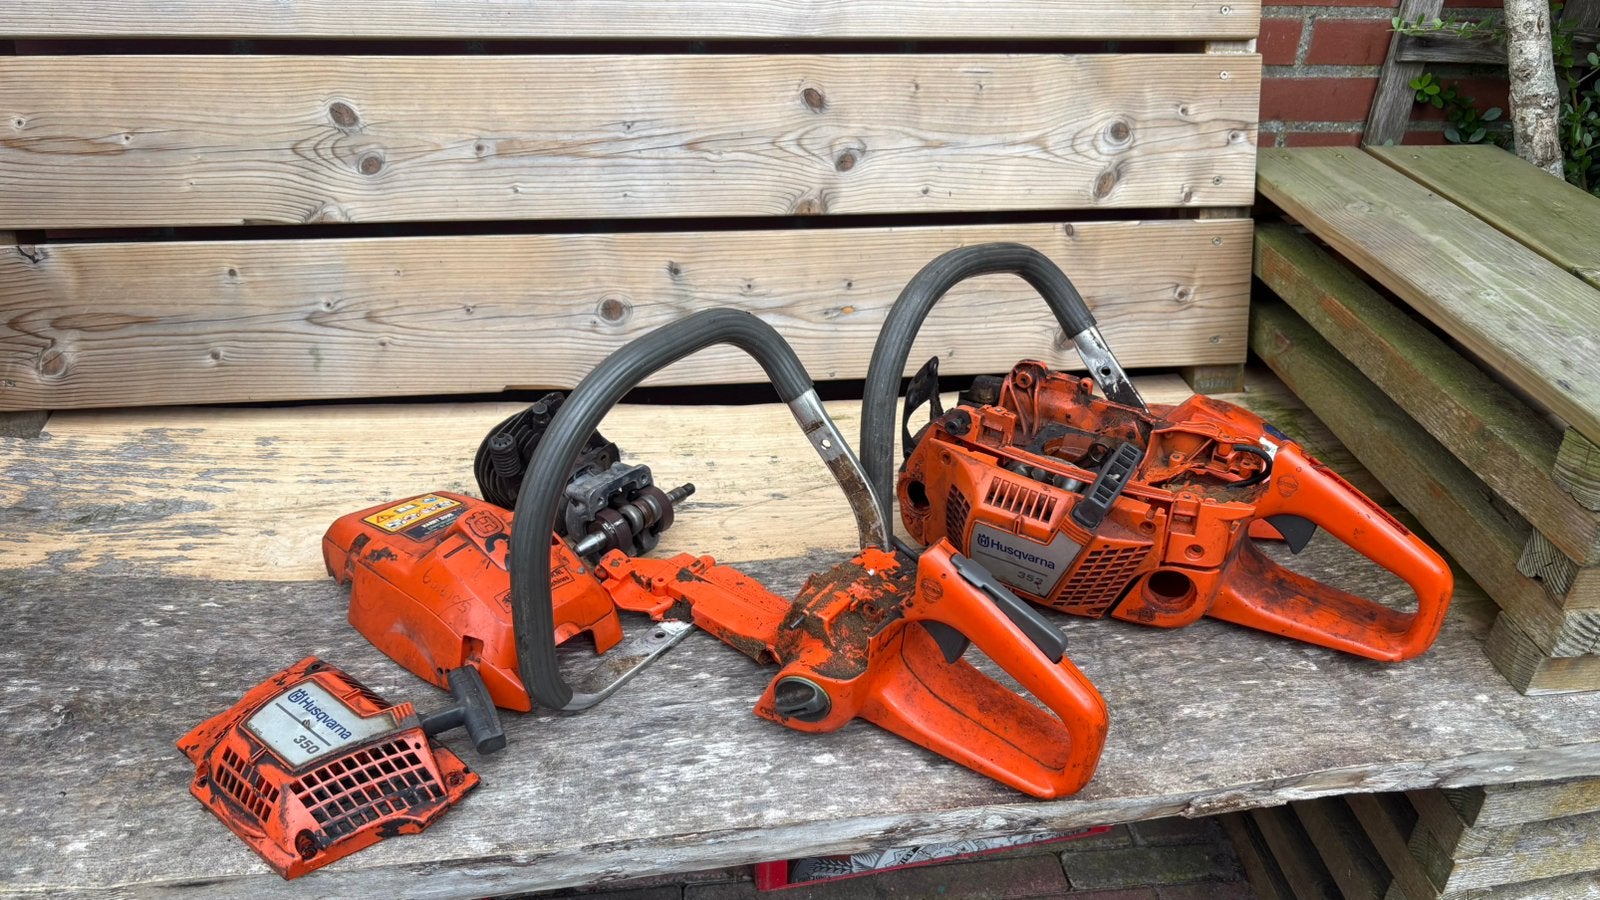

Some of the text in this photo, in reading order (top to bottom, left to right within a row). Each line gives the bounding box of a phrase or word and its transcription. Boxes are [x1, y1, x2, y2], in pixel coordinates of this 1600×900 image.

[991, 539, 1056, 570] Husqvarna
[299, 695, 353, 740] Husqvarna
[293, 735, 320, 755] 350
